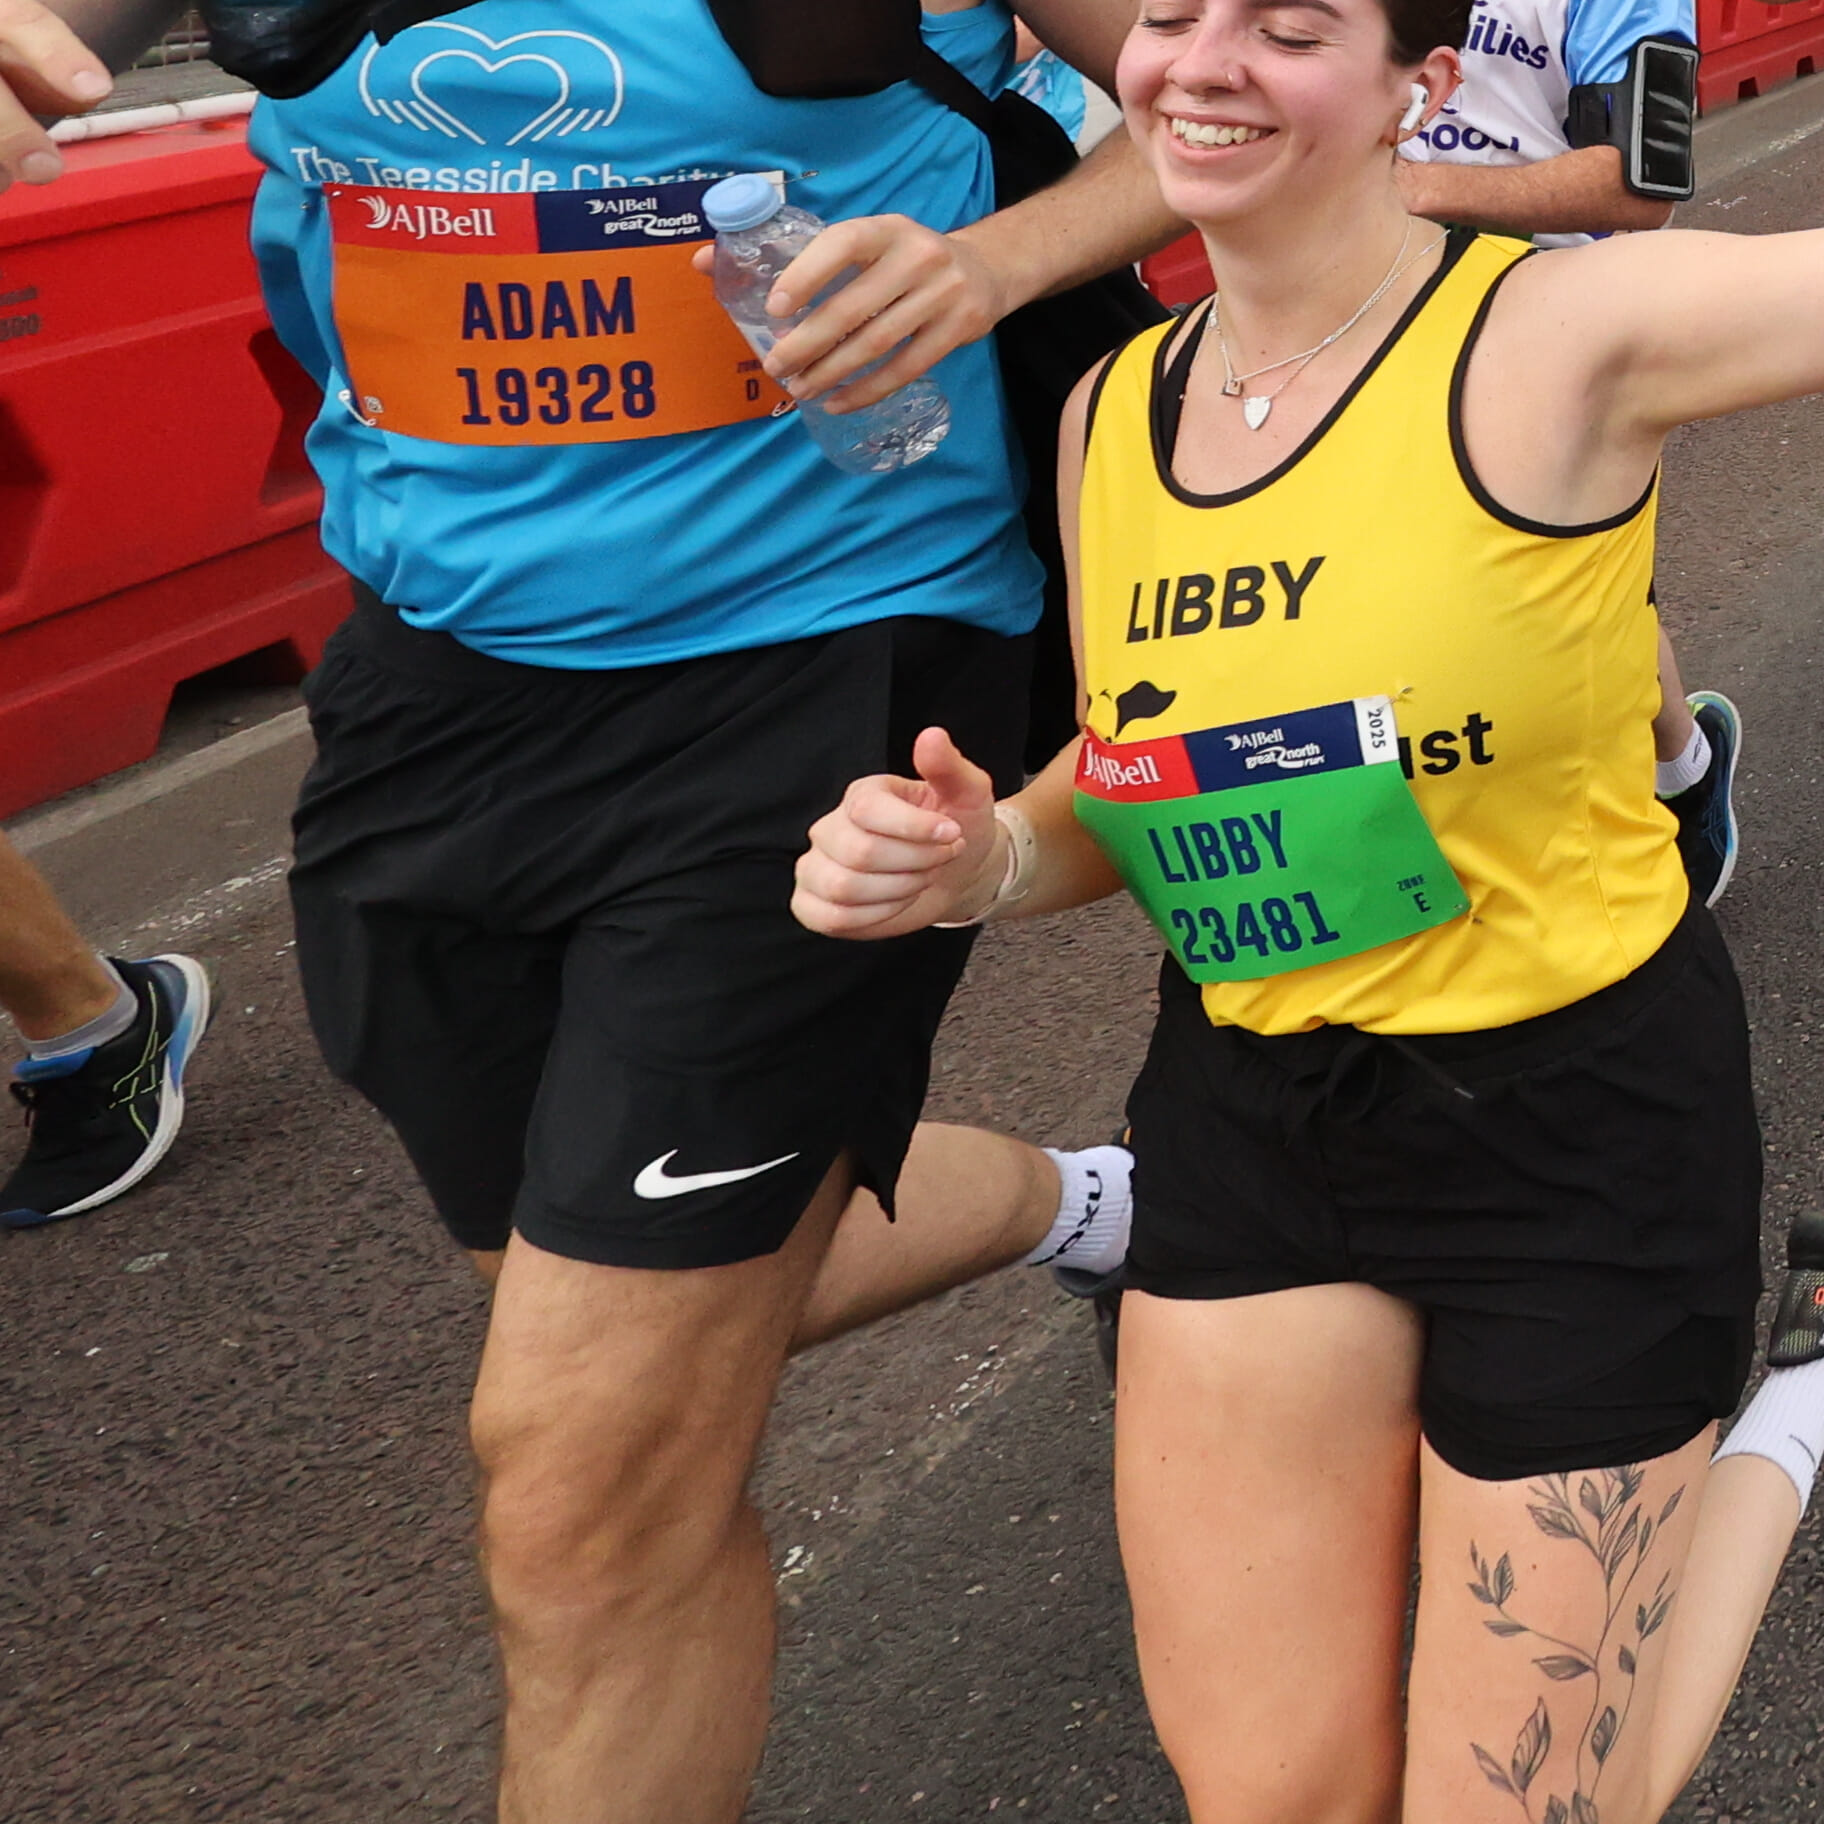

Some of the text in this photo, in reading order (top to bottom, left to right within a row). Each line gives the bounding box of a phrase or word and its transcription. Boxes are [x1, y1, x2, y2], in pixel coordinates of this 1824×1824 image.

[291, 148, 350, 184] The
[356, 158, 557, 193] Teesside
[391, 205, 497, 240] AJBell
[604, 198, 658, 214] AJBell
[604, 212, 698, 235] great north
[461, 277, 636, 341] ADAM
[456, 361, 656, 427] 19328
[1126, 556, 1326, 644] LIBBY
[1240, 728, 1284, 750] AJBell
[1367, 708, 1387, 750] 2025
[1092, 755, 1162, 790] AJBell
[1246, 742, 1321, 770] great north
[1147, 809, 1289, 884] LIBBY
[1413, 893, 1432, 913] E
[1170, 891, 1341, 965] 23481
